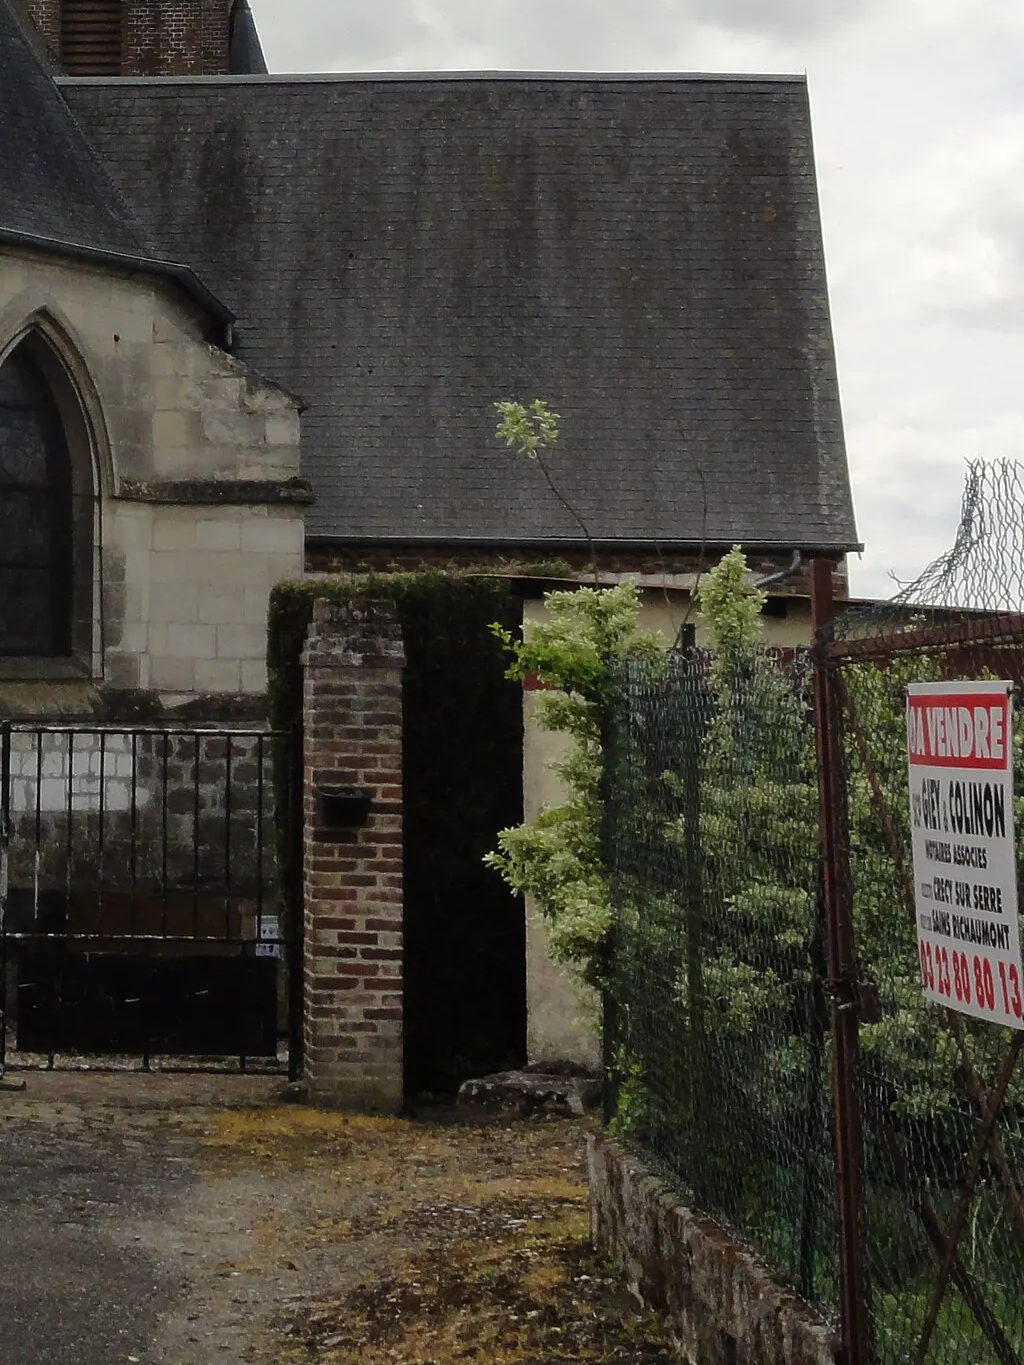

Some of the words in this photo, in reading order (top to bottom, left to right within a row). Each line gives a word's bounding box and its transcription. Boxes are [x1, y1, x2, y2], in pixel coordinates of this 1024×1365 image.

[926, 706, 1003, 759] VENDRE
[949, 780, 1006, 838] COLINON
[924, 839, 952, 864] NOTAIRES
[953, 844, 987, 869] ASSOCIES
[933, 876, 953, 904] CRECY
[955, 881, 971, 908] SUR
[973, 884, 1003, 913] SERRE
[932, 909, 951, 937] SAINS
[953, 915, 1010, 950] RICHAUMONT
[920, 939, 934, 991] 03
[936, 944, 951, 998] 23
[953, 950, 971, 1005] 80
[973, 955, 995, 1012] 80
[998, 961, 1022, 1019] 13
